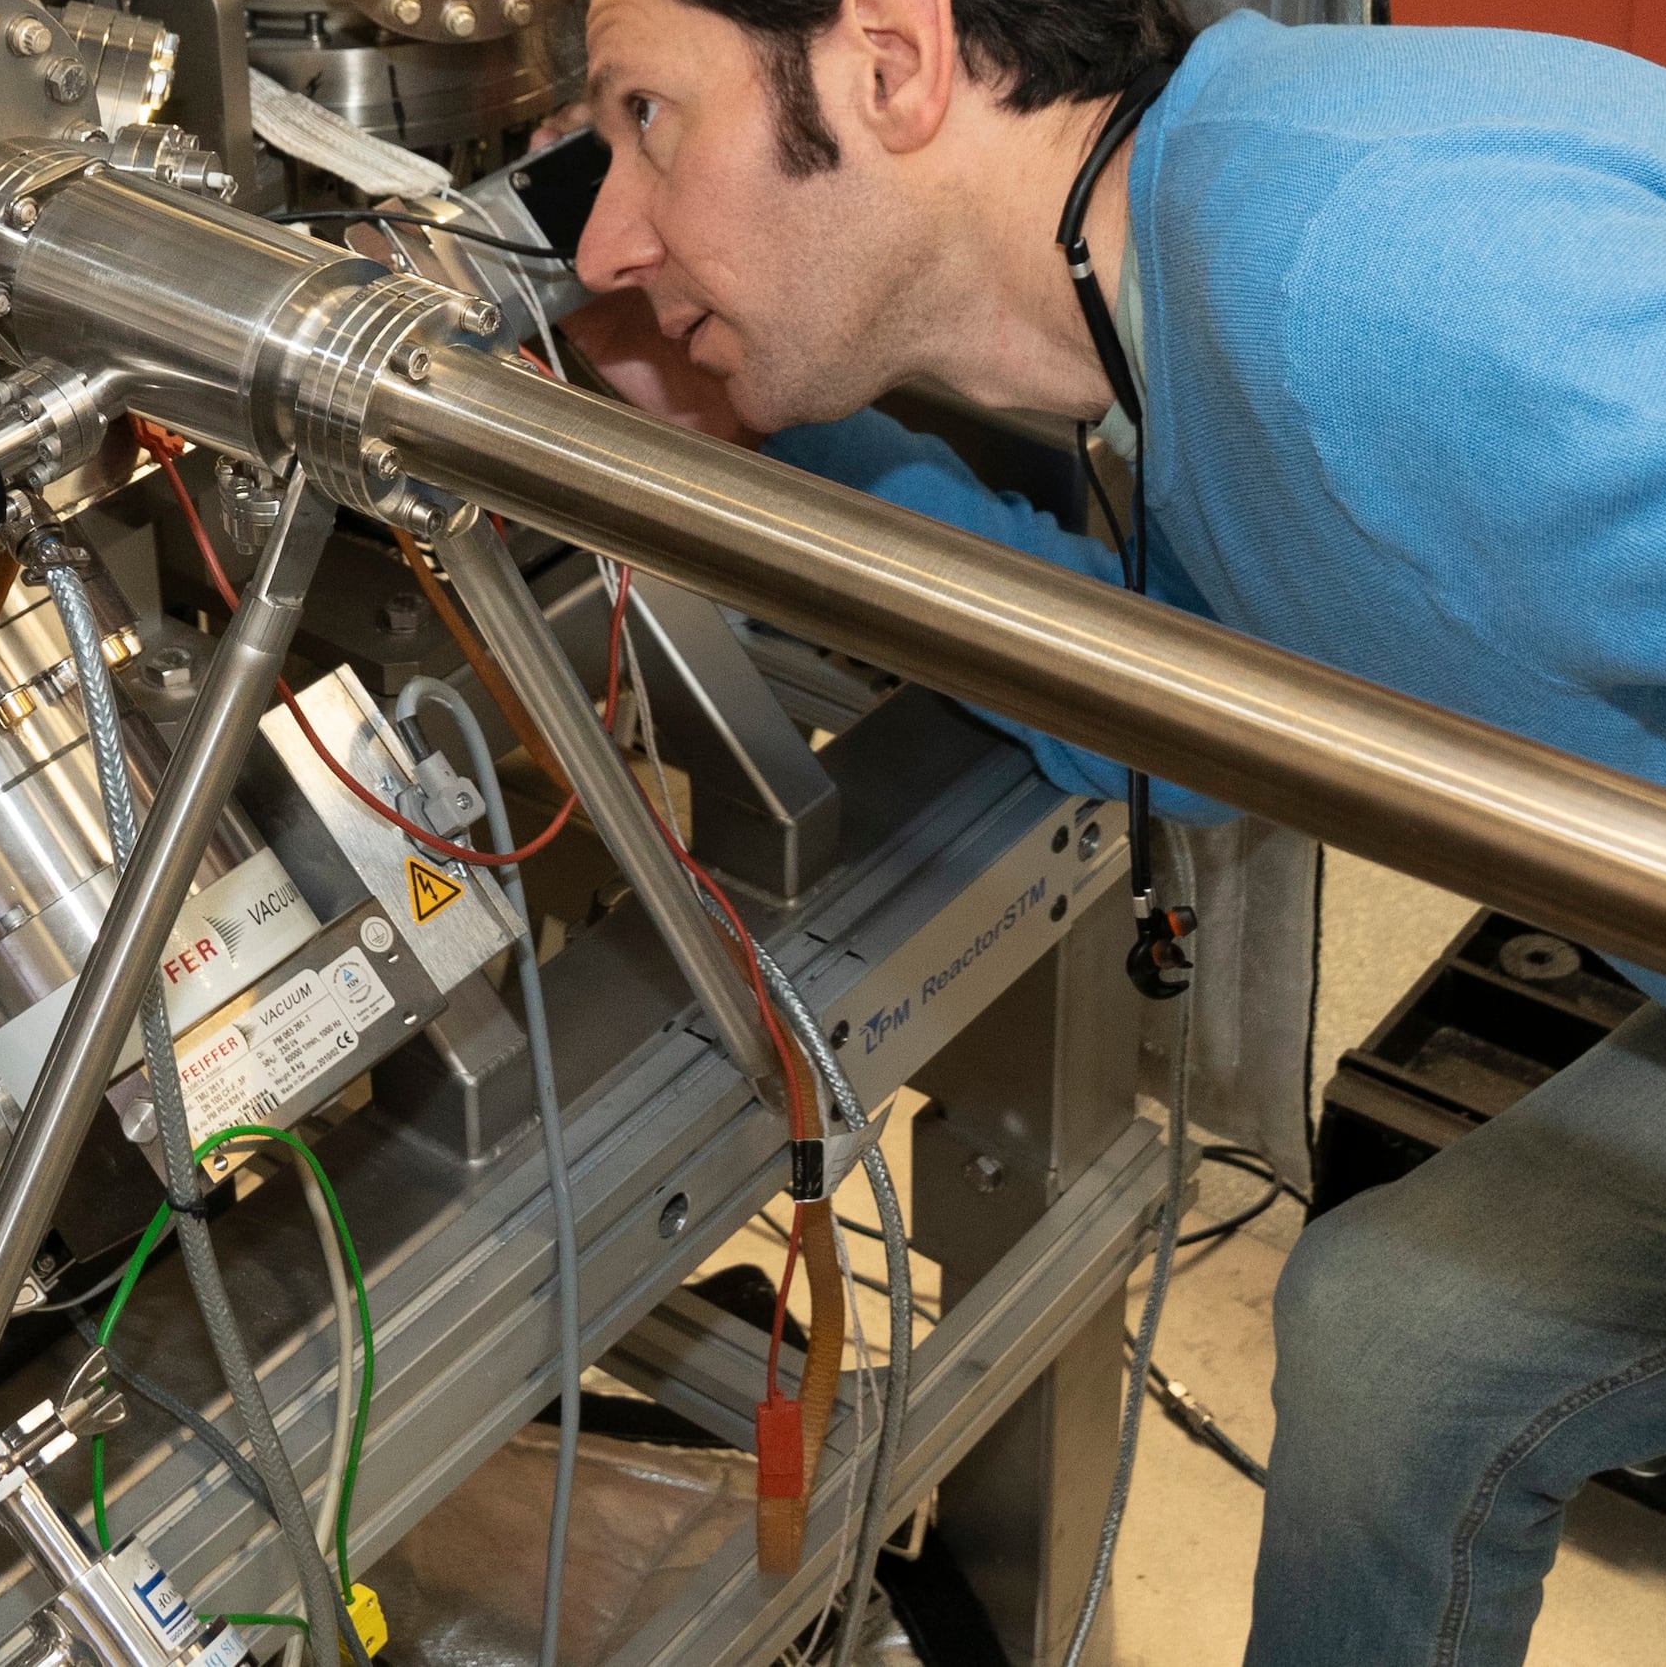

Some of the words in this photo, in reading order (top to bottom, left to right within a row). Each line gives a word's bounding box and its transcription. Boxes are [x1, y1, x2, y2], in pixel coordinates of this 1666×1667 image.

[176, 1035, 239, 1085] FEIFFER
[258, 982, 313, 1027] VACUUM
[863, 998, 910, 1054] LPM
[921, 877, 1046, 1005] ReactorSTM
